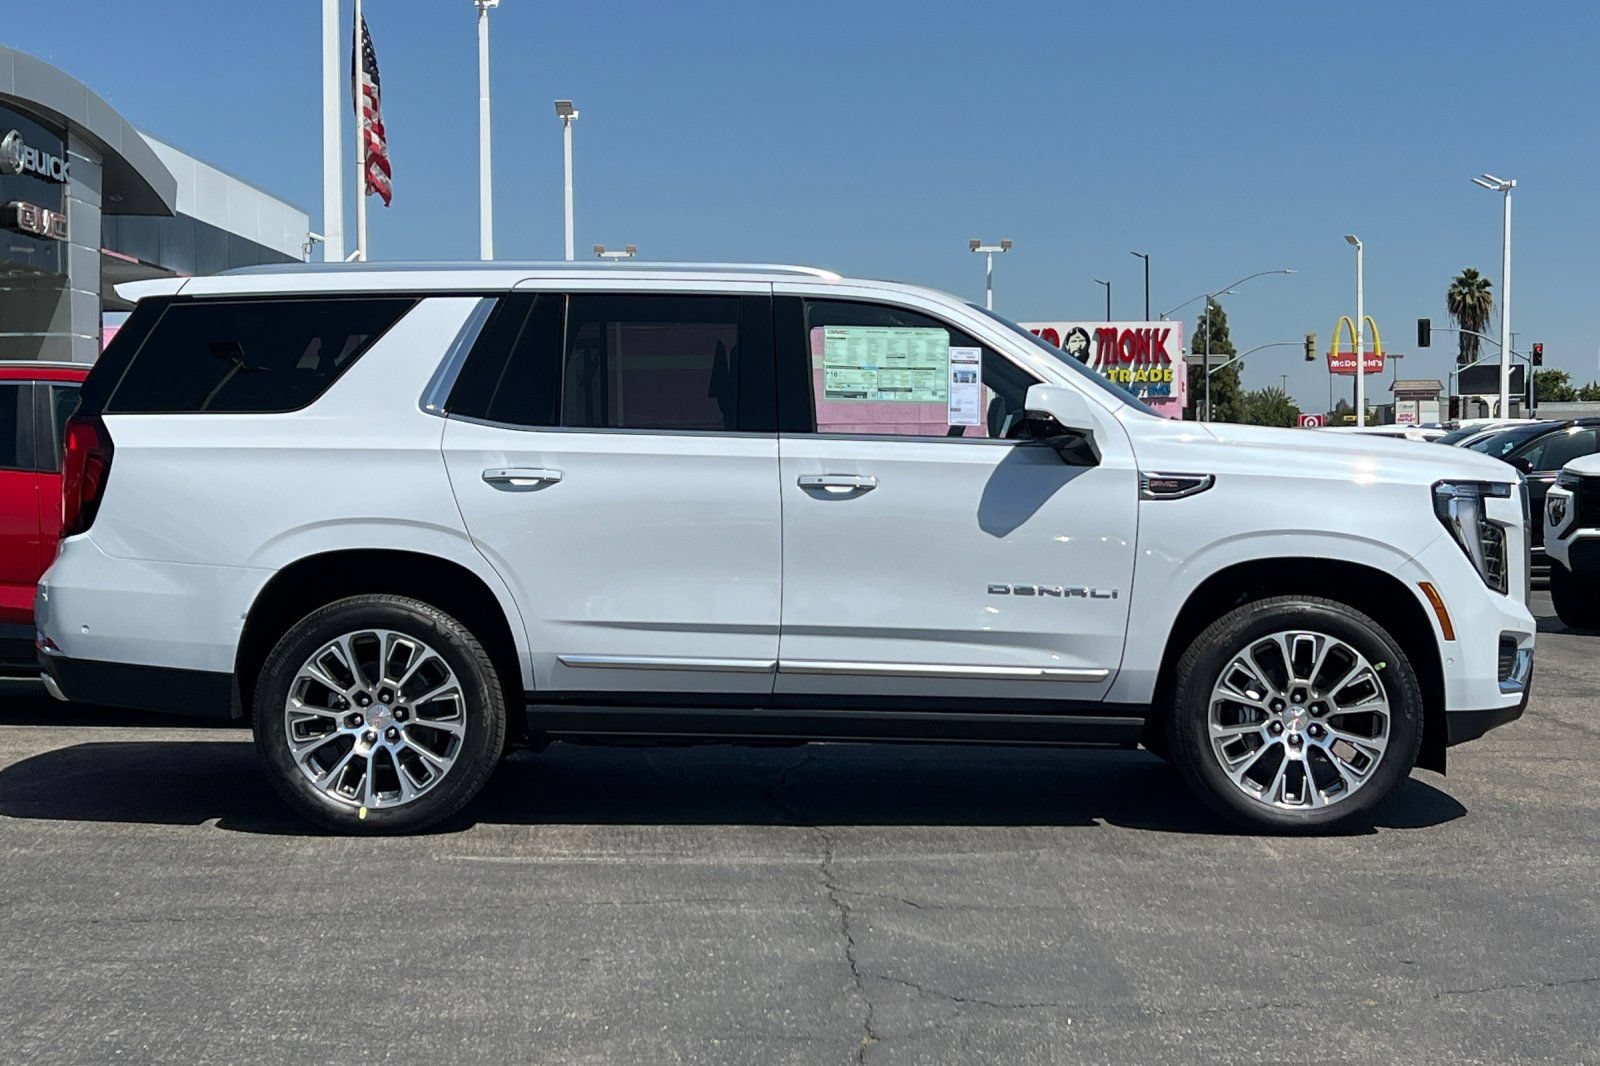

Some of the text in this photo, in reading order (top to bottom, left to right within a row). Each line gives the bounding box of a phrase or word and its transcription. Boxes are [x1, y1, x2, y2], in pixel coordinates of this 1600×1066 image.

[24, 145, 70, 182] BUICK
[18, 202, 68, 241] GMC
[1094, 327, 1171, 364] MONK
[1330, 359, 1383, 367] McDoald's
[1108, 368, 1173, 383] TRADE
[1150, 480, 1178, 488] GMC
[987, 583, 1119, 600] DENALI
